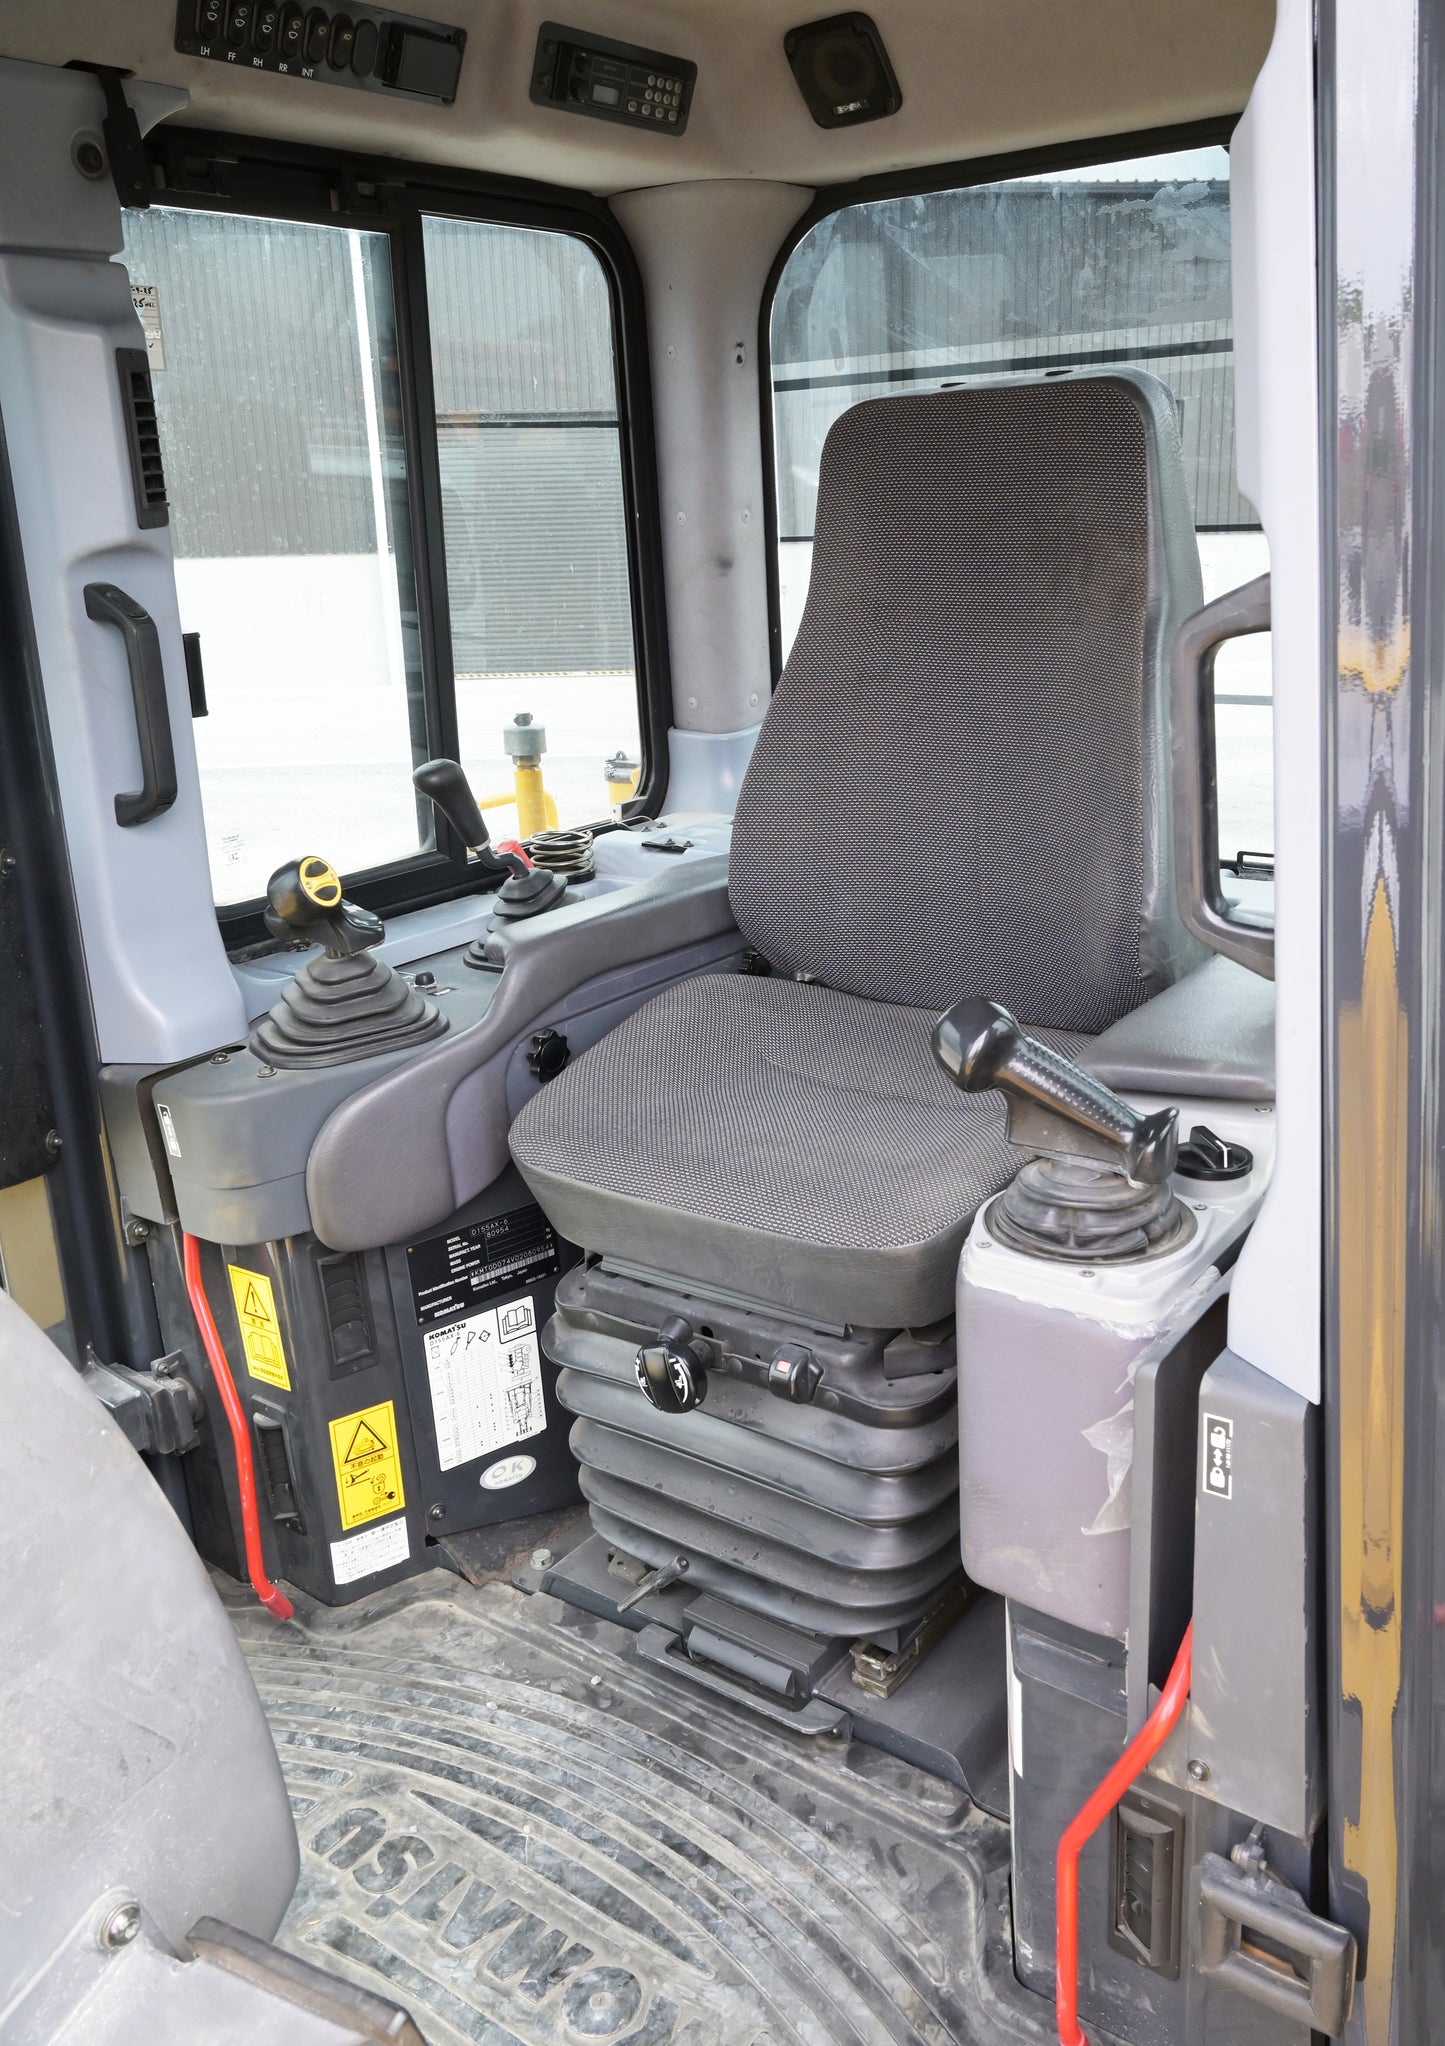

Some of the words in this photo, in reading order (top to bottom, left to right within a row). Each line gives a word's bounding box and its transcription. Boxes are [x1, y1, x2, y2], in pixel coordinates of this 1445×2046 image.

[201, 46, 210, 57] LH
[228, 51, 236, 61] FF
[253, 57, 263, 67] RH
[279, 63, 287, 72] RR
[302, 68, 313, 78] INT
[471, 1219, 508, 1236] D155AX-6
[486, 1226, 509, 1237] 80954
[434, 1302, 465, 1318] KOMATSU
[428, 1322, 467, 1341] KOMATSU
[429, 1331, 461, 1346] D155AX-6
